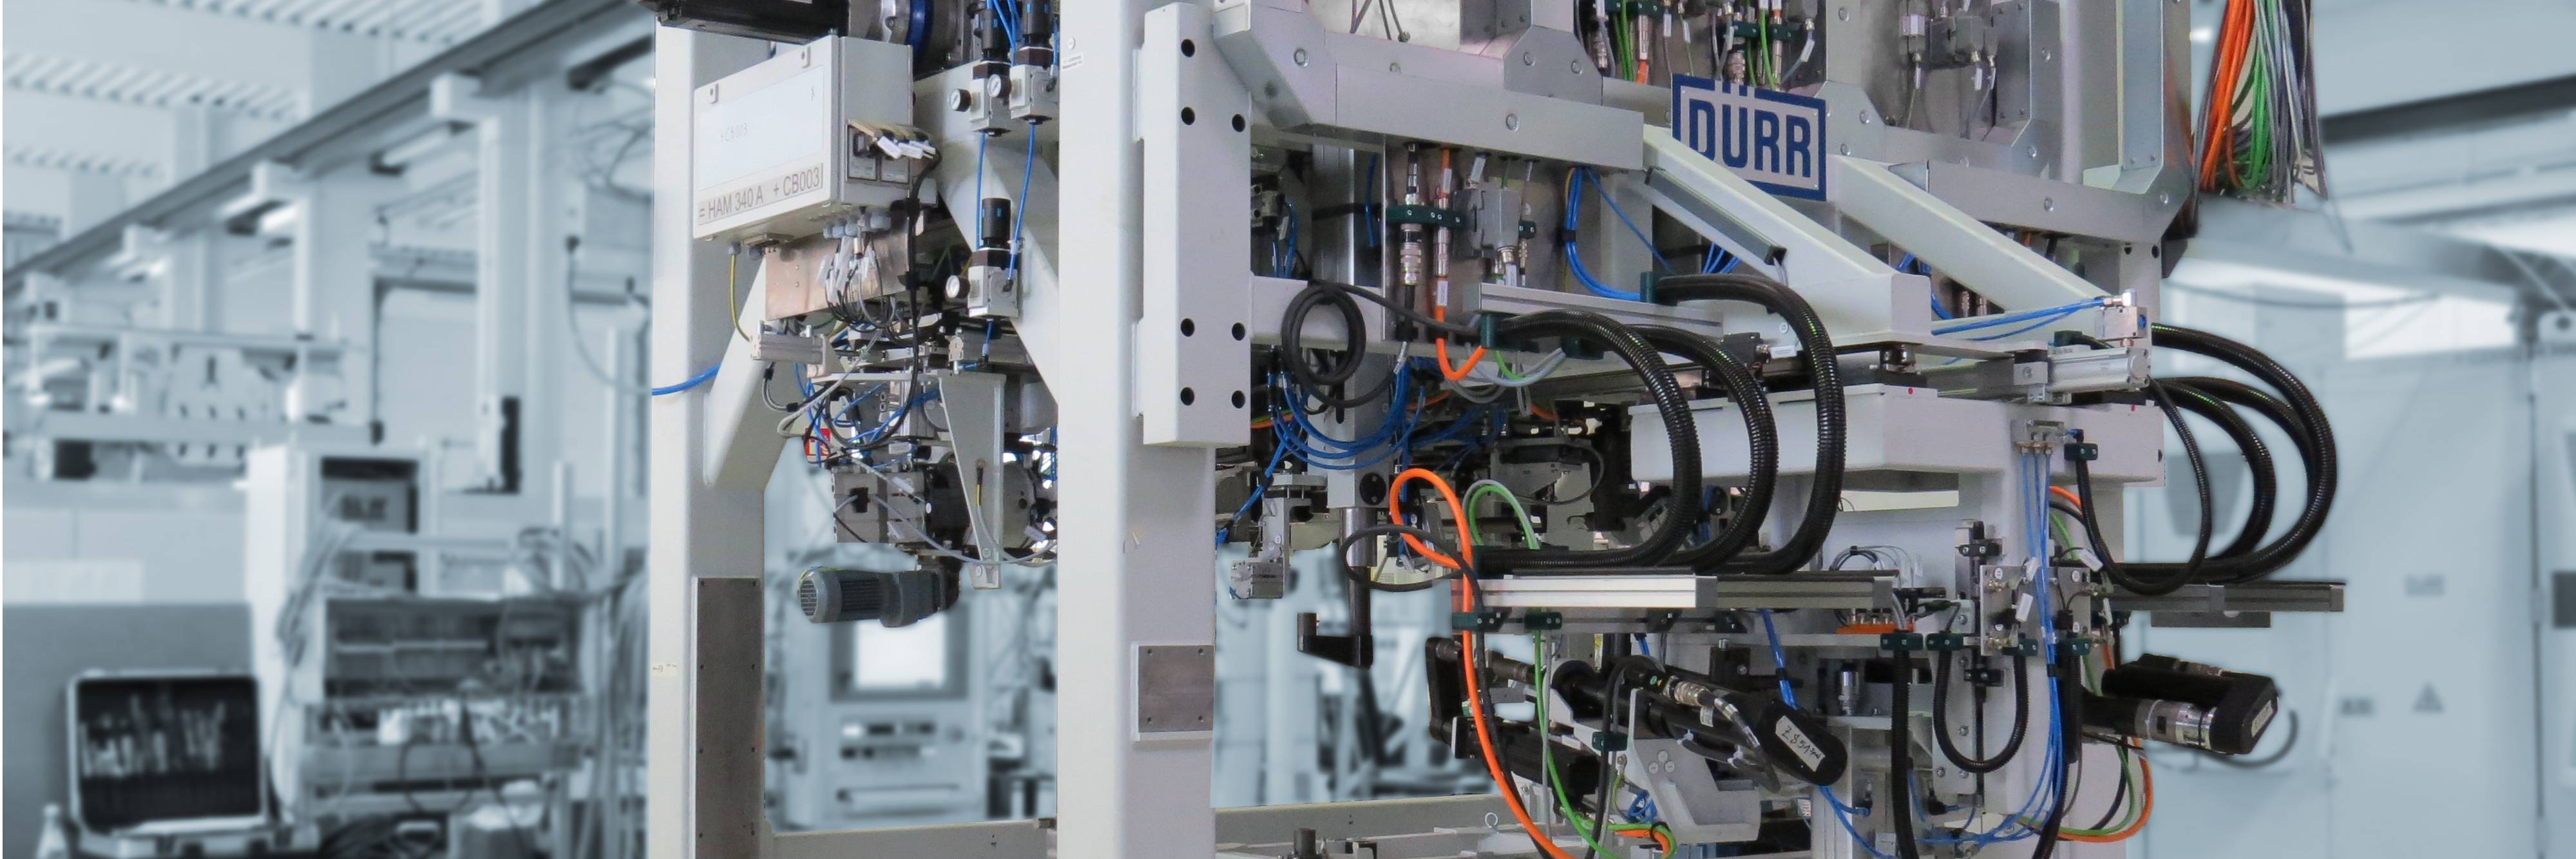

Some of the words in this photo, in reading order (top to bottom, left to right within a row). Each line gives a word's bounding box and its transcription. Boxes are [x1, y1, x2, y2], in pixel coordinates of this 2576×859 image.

[1689, 81, 1811, 178] DÜRR
[708, 194, 732, 220] HAM
[735, 188, 754, 211] 340
[756, 185, 764, 205] A
[783, 166, 820, 197] CB003
